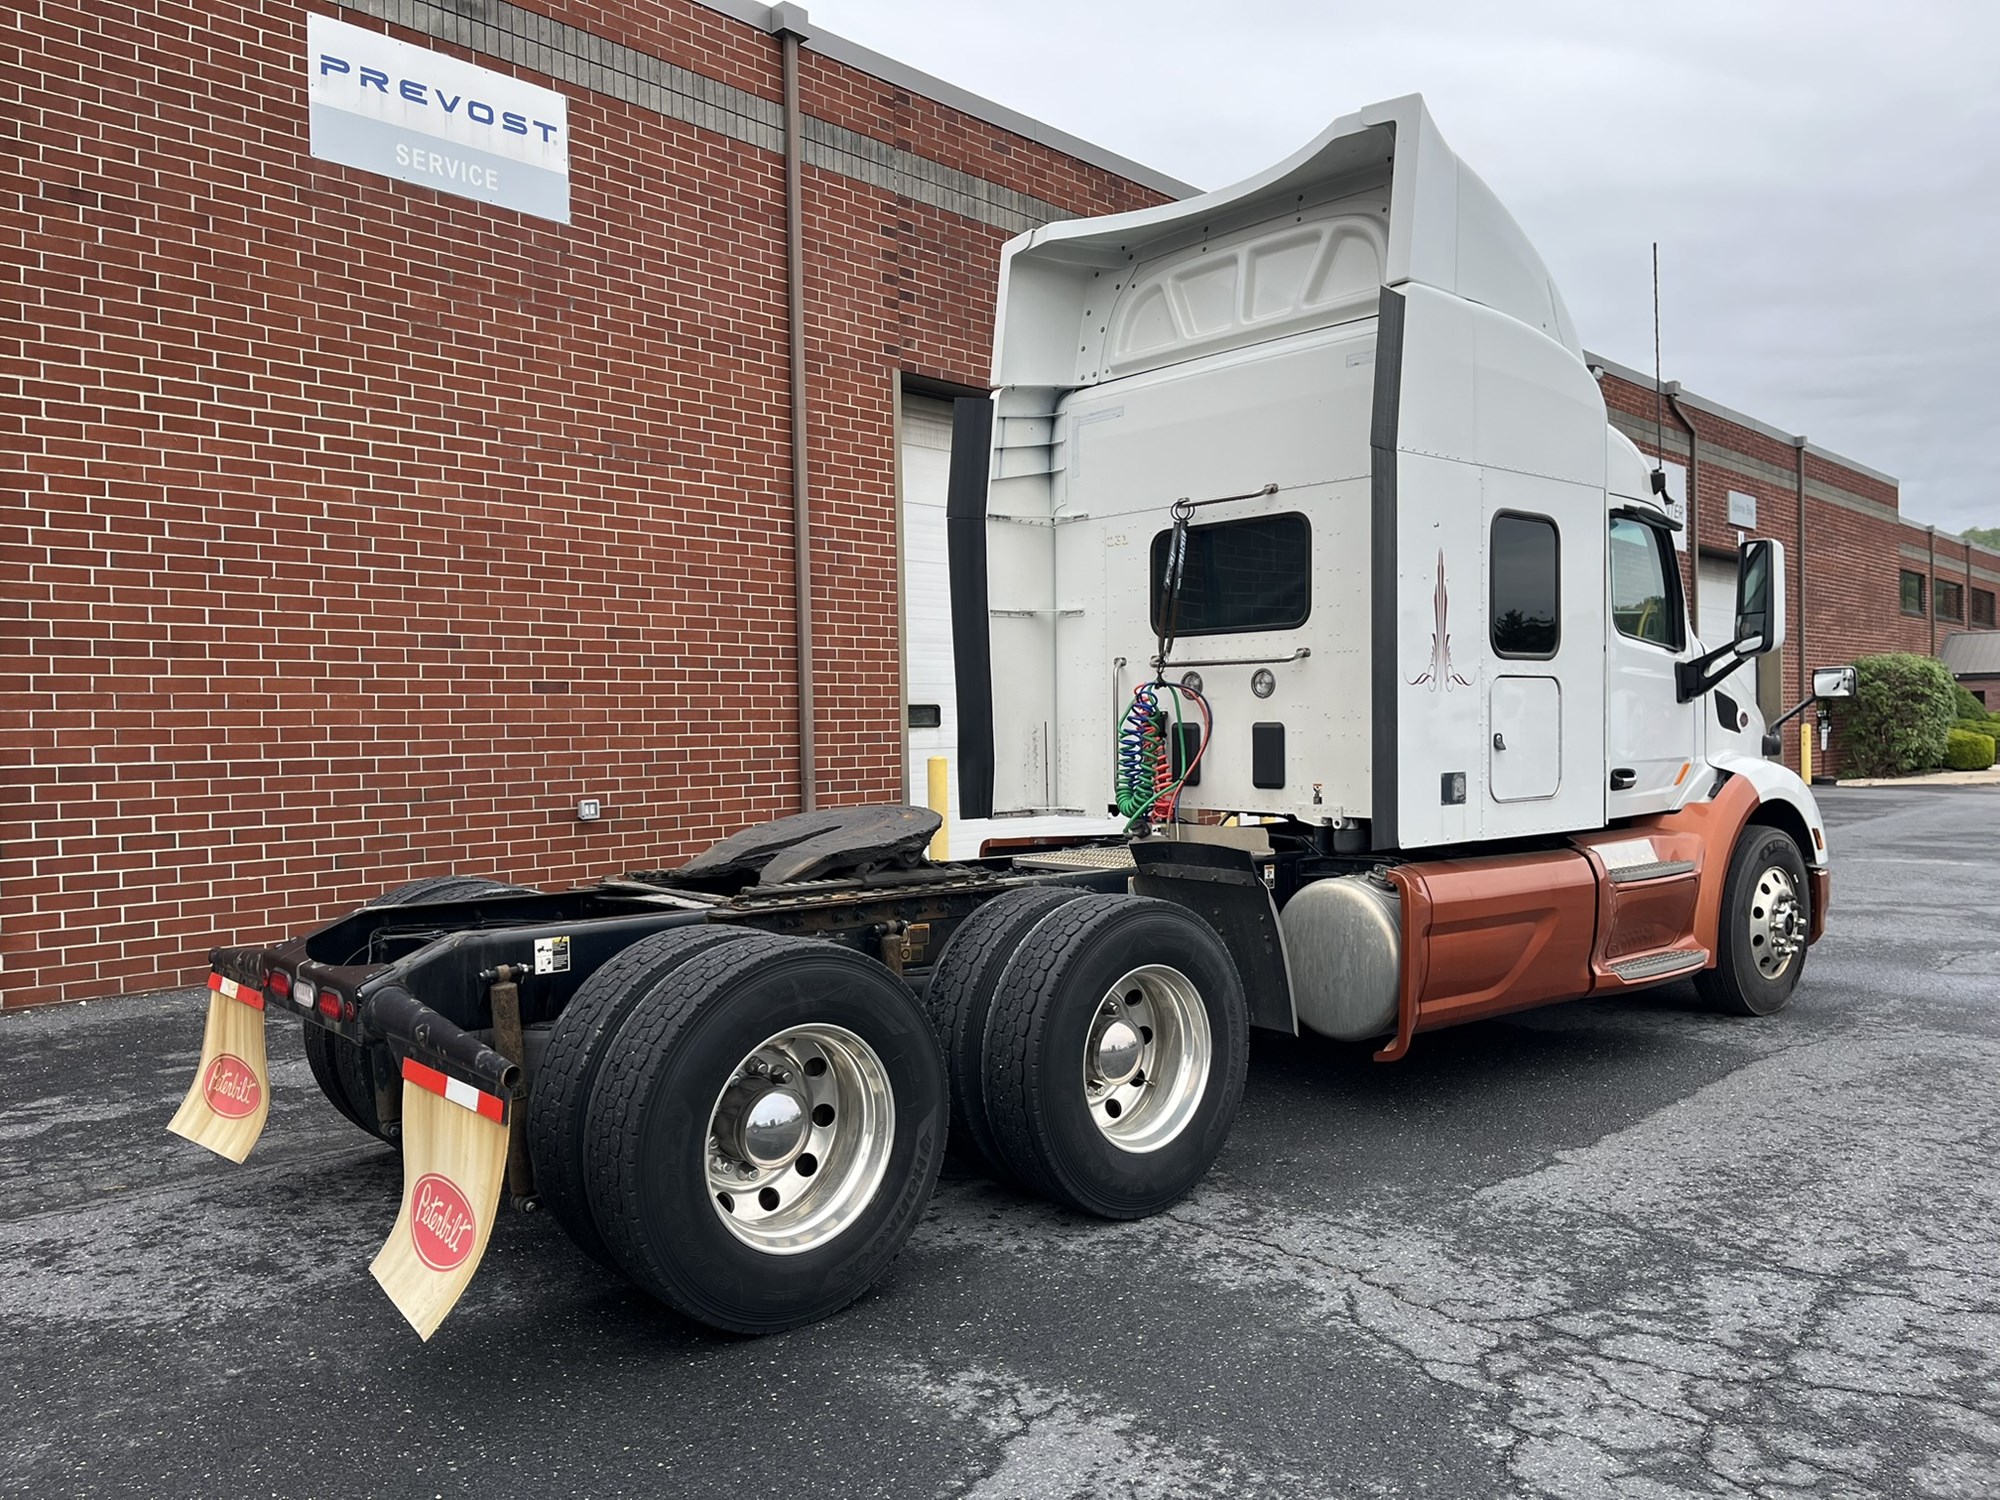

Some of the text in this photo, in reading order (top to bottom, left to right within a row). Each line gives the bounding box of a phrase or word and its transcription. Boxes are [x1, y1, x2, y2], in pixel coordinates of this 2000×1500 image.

[320, 54, 558, 143] PREVOST
[395, 143, 499, 191] SERVICE
[1666, 504, 1684, 520] NTER
[207, 1059, 256, 1105] Peterbilt
[415, 1182, 473, 1254] Peterbilt
